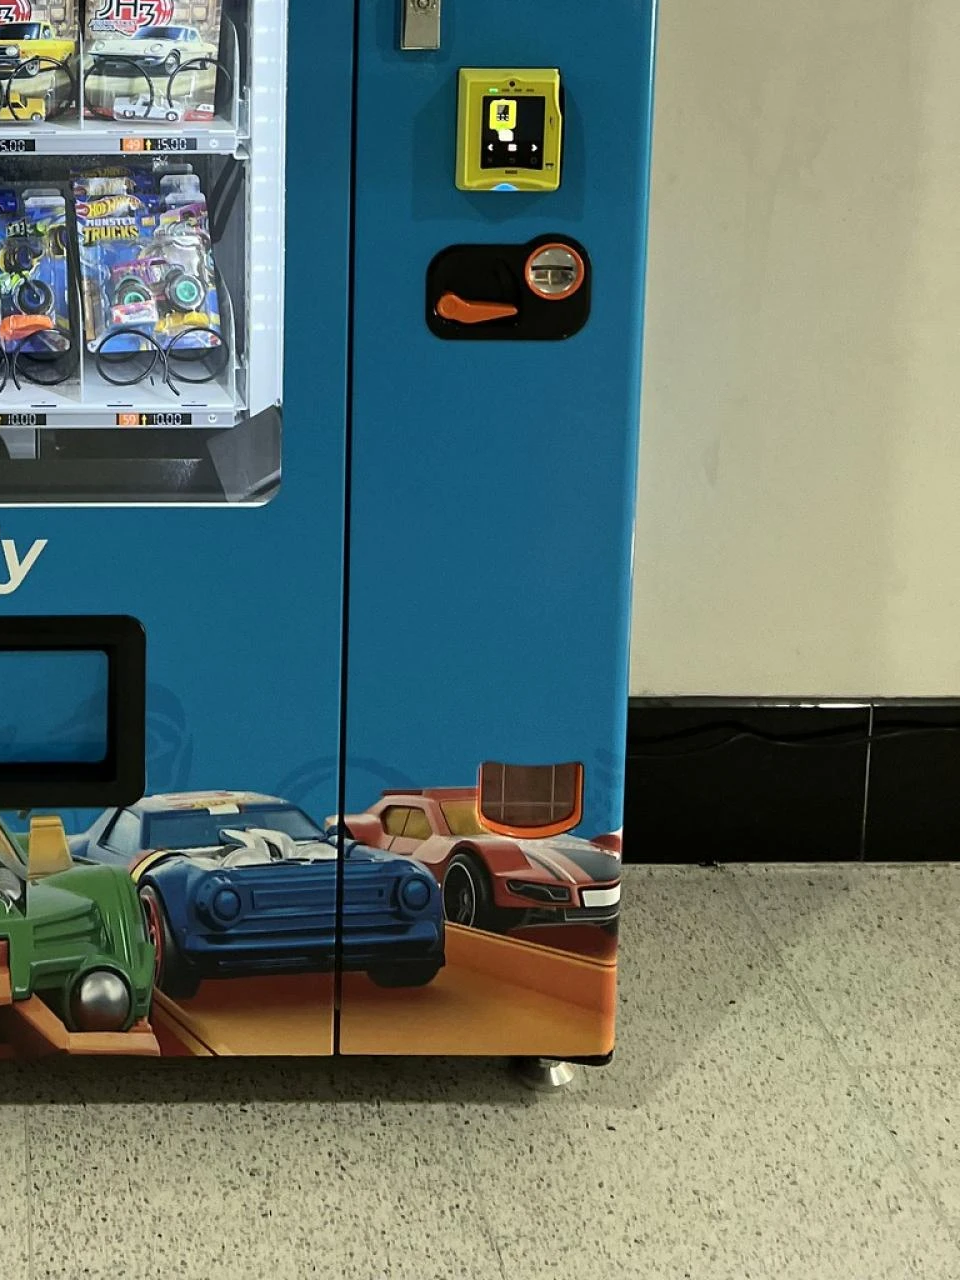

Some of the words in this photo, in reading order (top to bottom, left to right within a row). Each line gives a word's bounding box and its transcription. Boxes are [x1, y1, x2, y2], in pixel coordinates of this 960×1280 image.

[129, 140, 142, 151] 49
[83, 226, 138, 244] TRUCKS
[123, 415, 136, 425] 59
